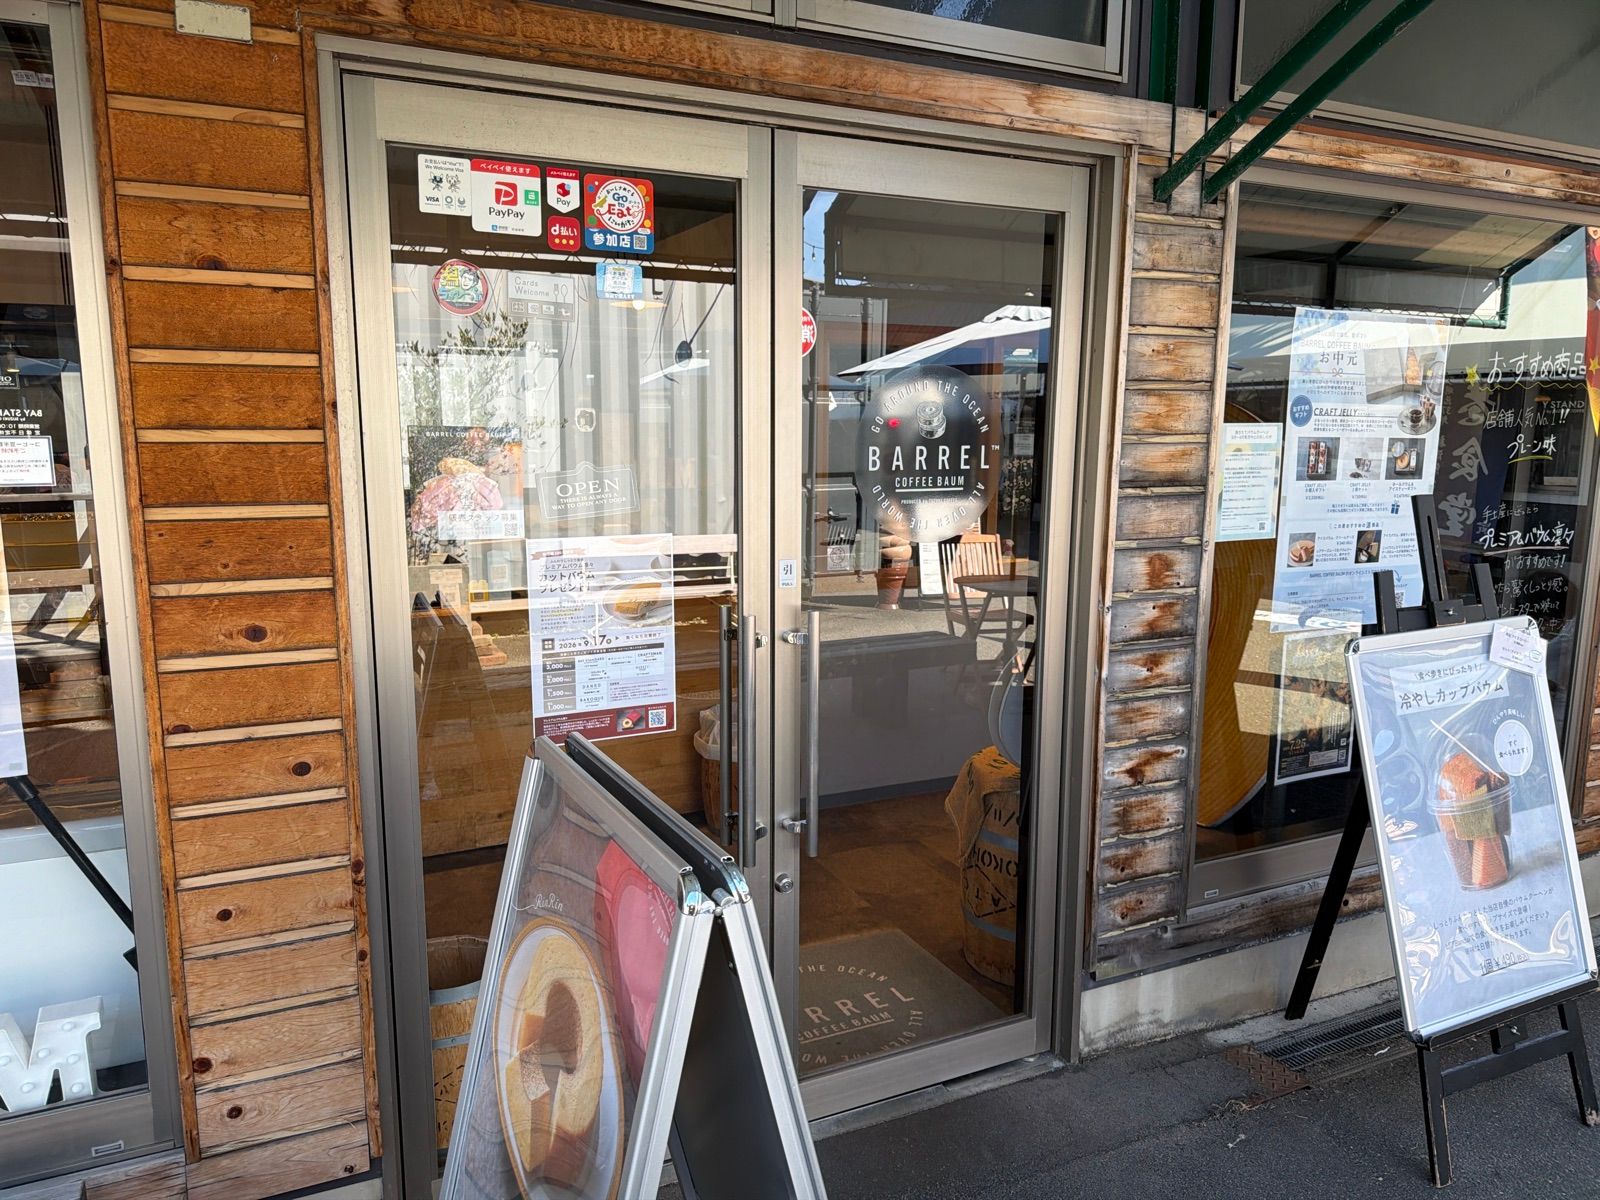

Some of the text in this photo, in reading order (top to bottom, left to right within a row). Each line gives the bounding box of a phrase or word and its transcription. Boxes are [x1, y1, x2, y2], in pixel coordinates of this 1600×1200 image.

[480, 163, 531, 174] ペイペイ使えます
[556, 197, 571, 207] Pay
[612, 192, 628, 202] Go
[488, 206, 525, 220] PayPay
[608, 204, 632, 218] Eat
[551, 224, 578, 236] d払い
[593, 233, 630, 248] 参加店
[514, 276, 539, 287] Cards
[514, 286, 550, 296] Welcome
[1320, 351, 1358, 366] お中元
[1487, 348, 1586, 383] おすすめ商品
[871, 380, 990, 434] GO AROUND THE OCEAN
[1551, 400, 1584, 408] STAND
[1314, 408, 1336, 416] CRAFT
[1338, 408, 1358, 416] JELLY
[1507, 434, 1556, 458] プレーン味
[868, 445, 990, 471] BARREL
[556, 478, 620, 497] OPEN
[895, 476, 964, 488] COFFEE BAUM
[968, 482, 984, 504] ALL
[872, 484, 904, 522] WORLD
[937, 506, 966, 526] OVER
[910, 518, 928, 529] THE
[1504, 554, 1566, 569] がおすすめです!
[784, 564, 792, 575] 引
[1400, 680, 1504, 710] 冷やしカップバウム
[837, 965, 888, 982] OCEAN
[851, 1012, 892, 1026] BAUM
[908, 1010, 923, 1026] ALL
